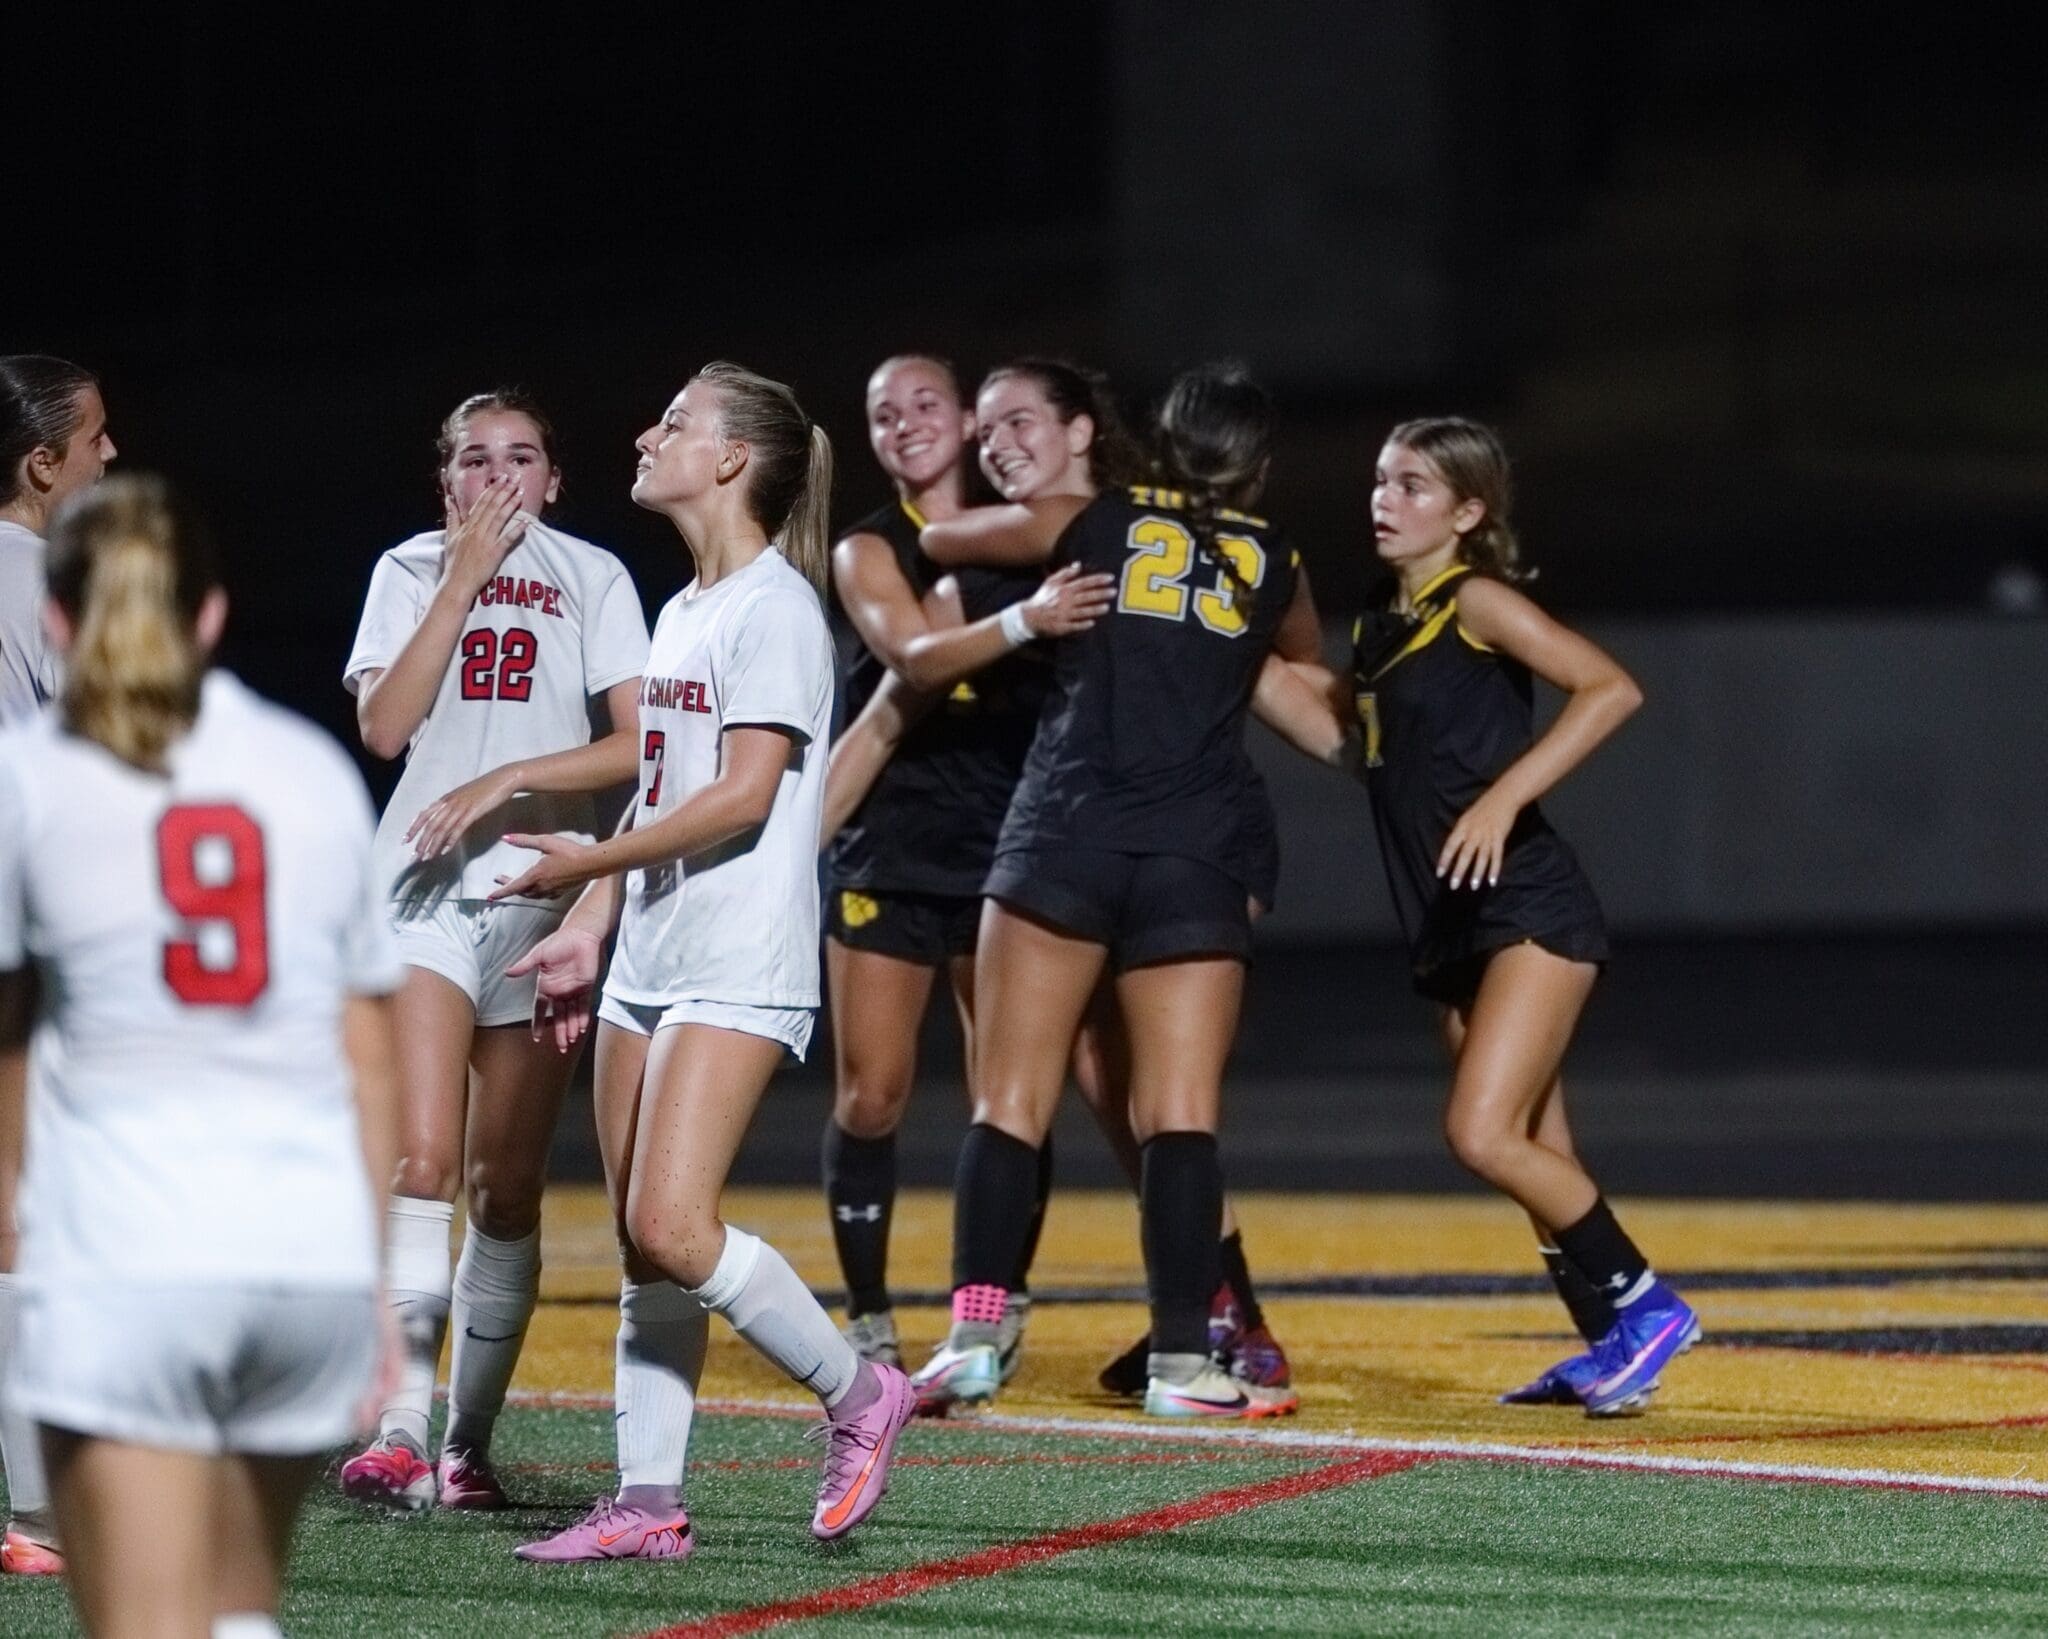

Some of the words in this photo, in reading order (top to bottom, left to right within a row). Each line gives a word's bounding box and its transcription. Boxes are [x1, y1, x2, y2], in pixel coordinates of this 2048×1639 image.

[480, 576, 565, 618] CHAPEL
[1117, 514, 1267, 639] 23
[461, 627, 538, 702] 22
[648, 676, 712, 714] CHAPEL
[157, 801, 270, 1009] 9
